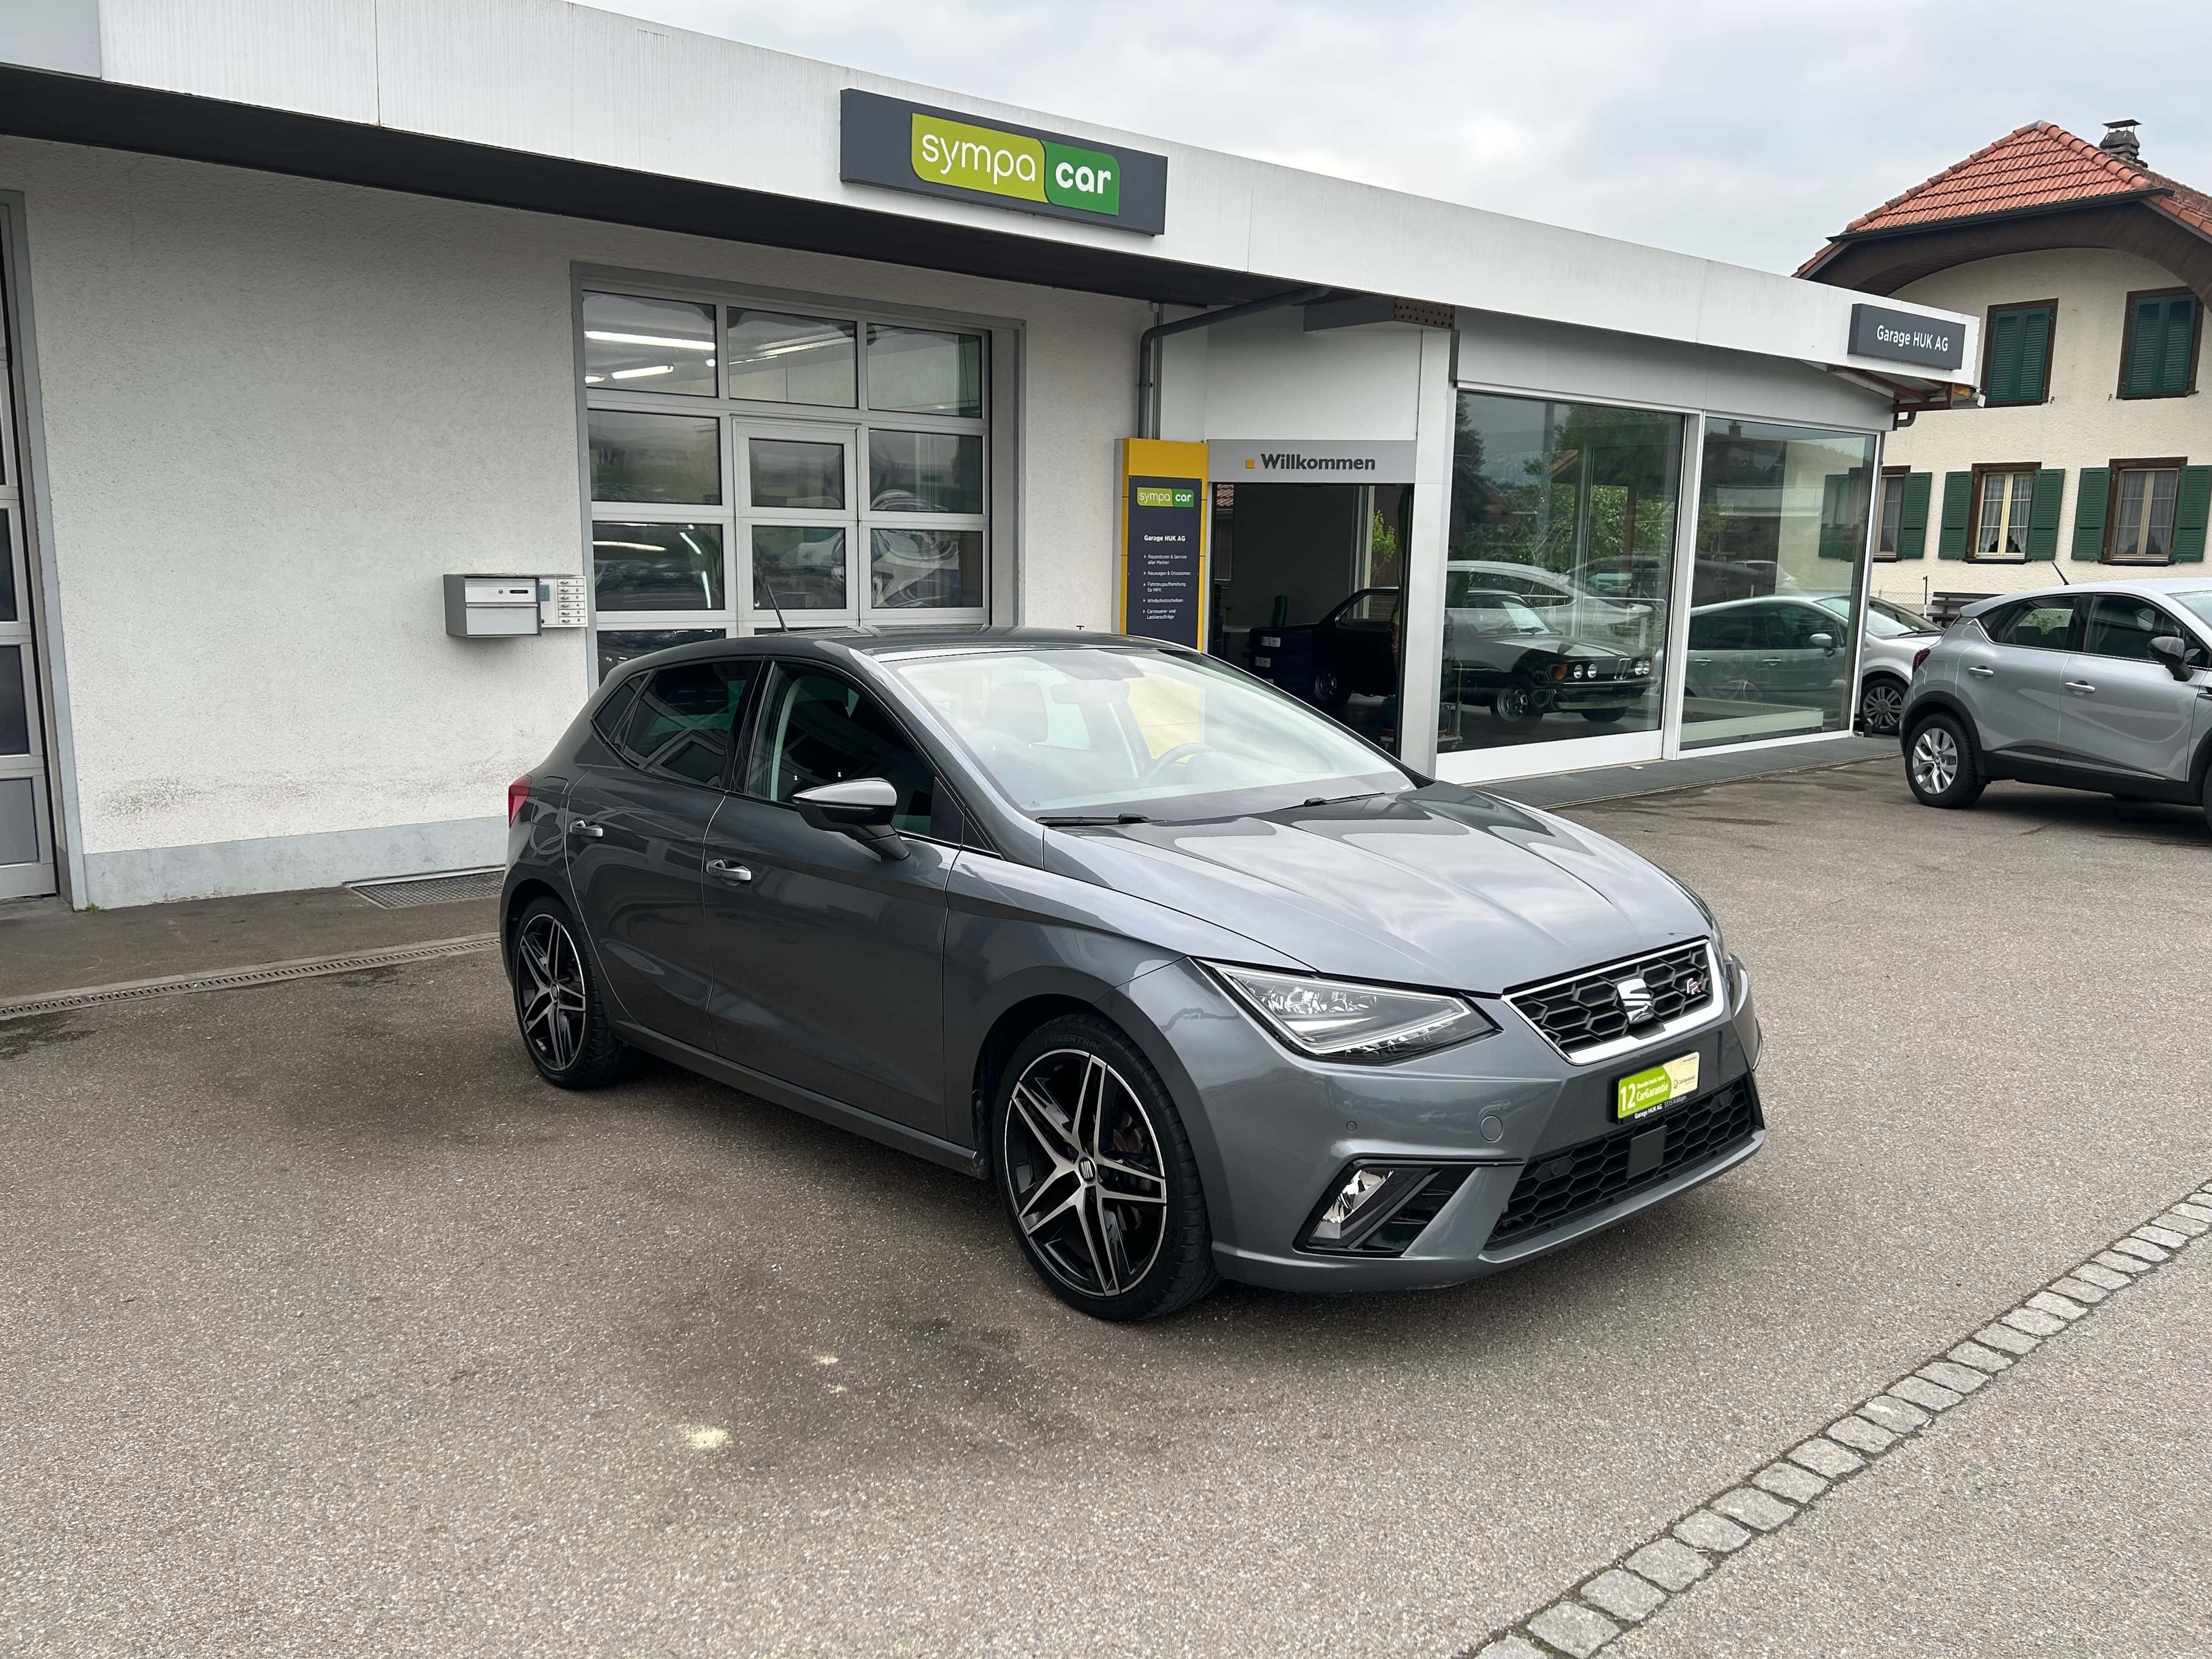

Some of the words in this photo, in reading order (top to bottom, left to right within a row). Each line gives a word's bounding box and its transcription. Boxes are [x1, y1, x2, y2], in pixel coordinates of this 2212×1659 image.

[922, 133, 1036, 184] sympa
[1055, 161, 1111, 194] car
[1877, 324, 1911, 347] Garage
[1912, 331, 1933, 350] HUK
[1934, 336, 1949, 352] AG
[1260, 453, 1376, 471] Willkommen
[1139, 493, 1171, 504] sympa
[1175, 494, 1192, 502] car
[1620, 1082, 1636, 1112] 12
[1636, 1082, 1669, 1102] CarGarantie
[1634, 1110, 1648, 1119] Garage
[1647, 1105, 1657, 1114] HUK
